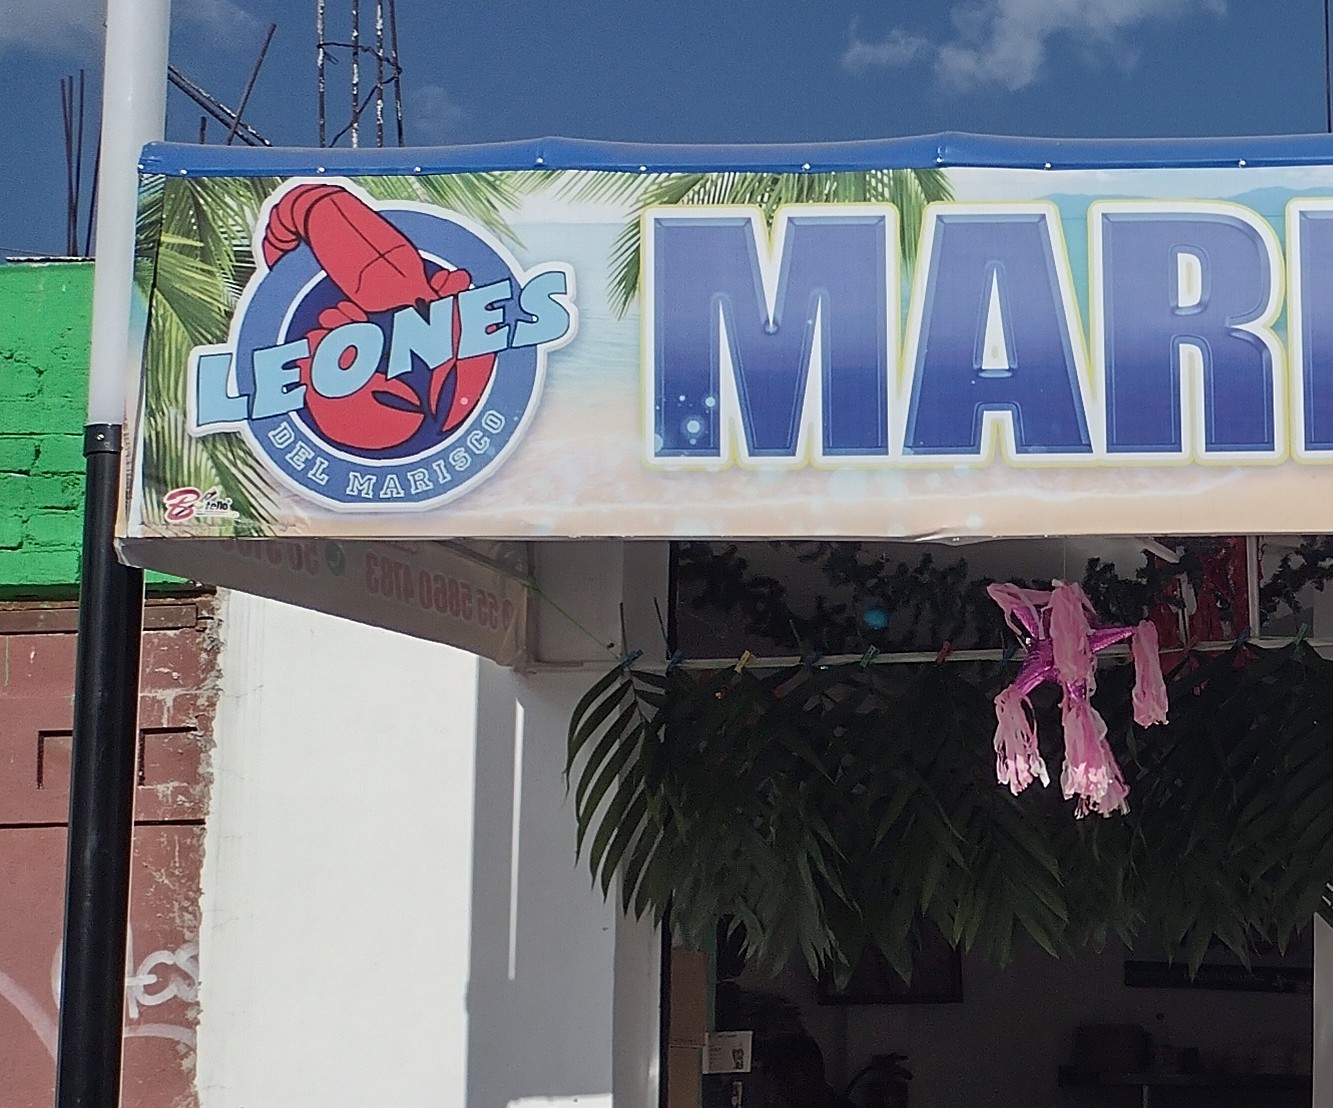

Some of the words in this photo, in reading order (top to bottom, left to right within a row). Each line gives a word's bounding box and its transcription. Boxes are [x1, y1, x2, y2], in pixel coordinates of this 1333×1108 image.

[195, 270, 571, 427] LEONES
[267, 422, 330, 486] DEL
[346, 408, 506, 499] MARISCO
